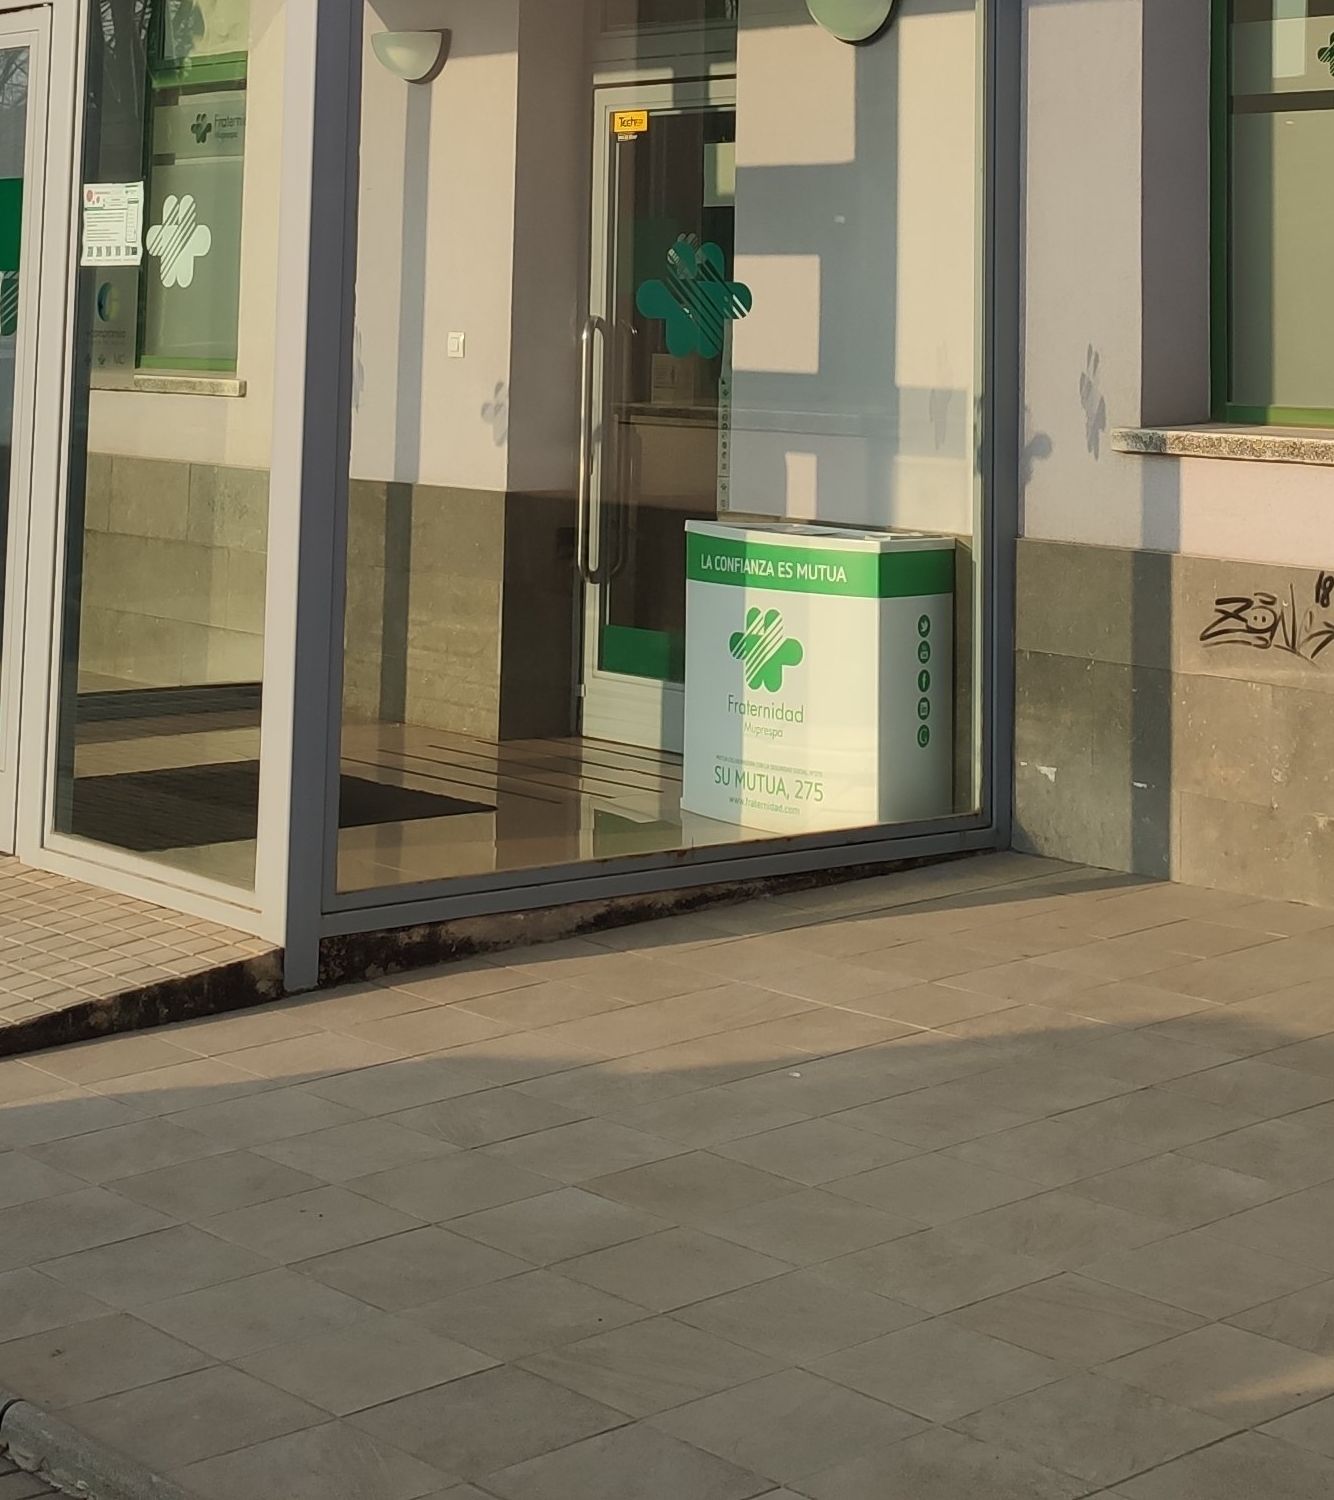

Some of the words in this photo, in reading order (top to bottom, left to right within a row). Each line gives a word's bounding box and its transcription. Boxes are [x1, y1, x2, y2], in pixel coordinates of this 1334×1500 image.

[700, 553, 713, 570] LA
[714, 555, 774, 577] CONFIANZA
[777, 561, 793, 579] ES
[796, 563, 848, 583] MUTUA
[727, 694, 804, 723] Fraternidad
[744, 721, 784, 740] Muprespa
[714, 764, 731, 786] SU
[734, 768, 790, 800] MUTUA,
[794, 779, 824, 802] 275
